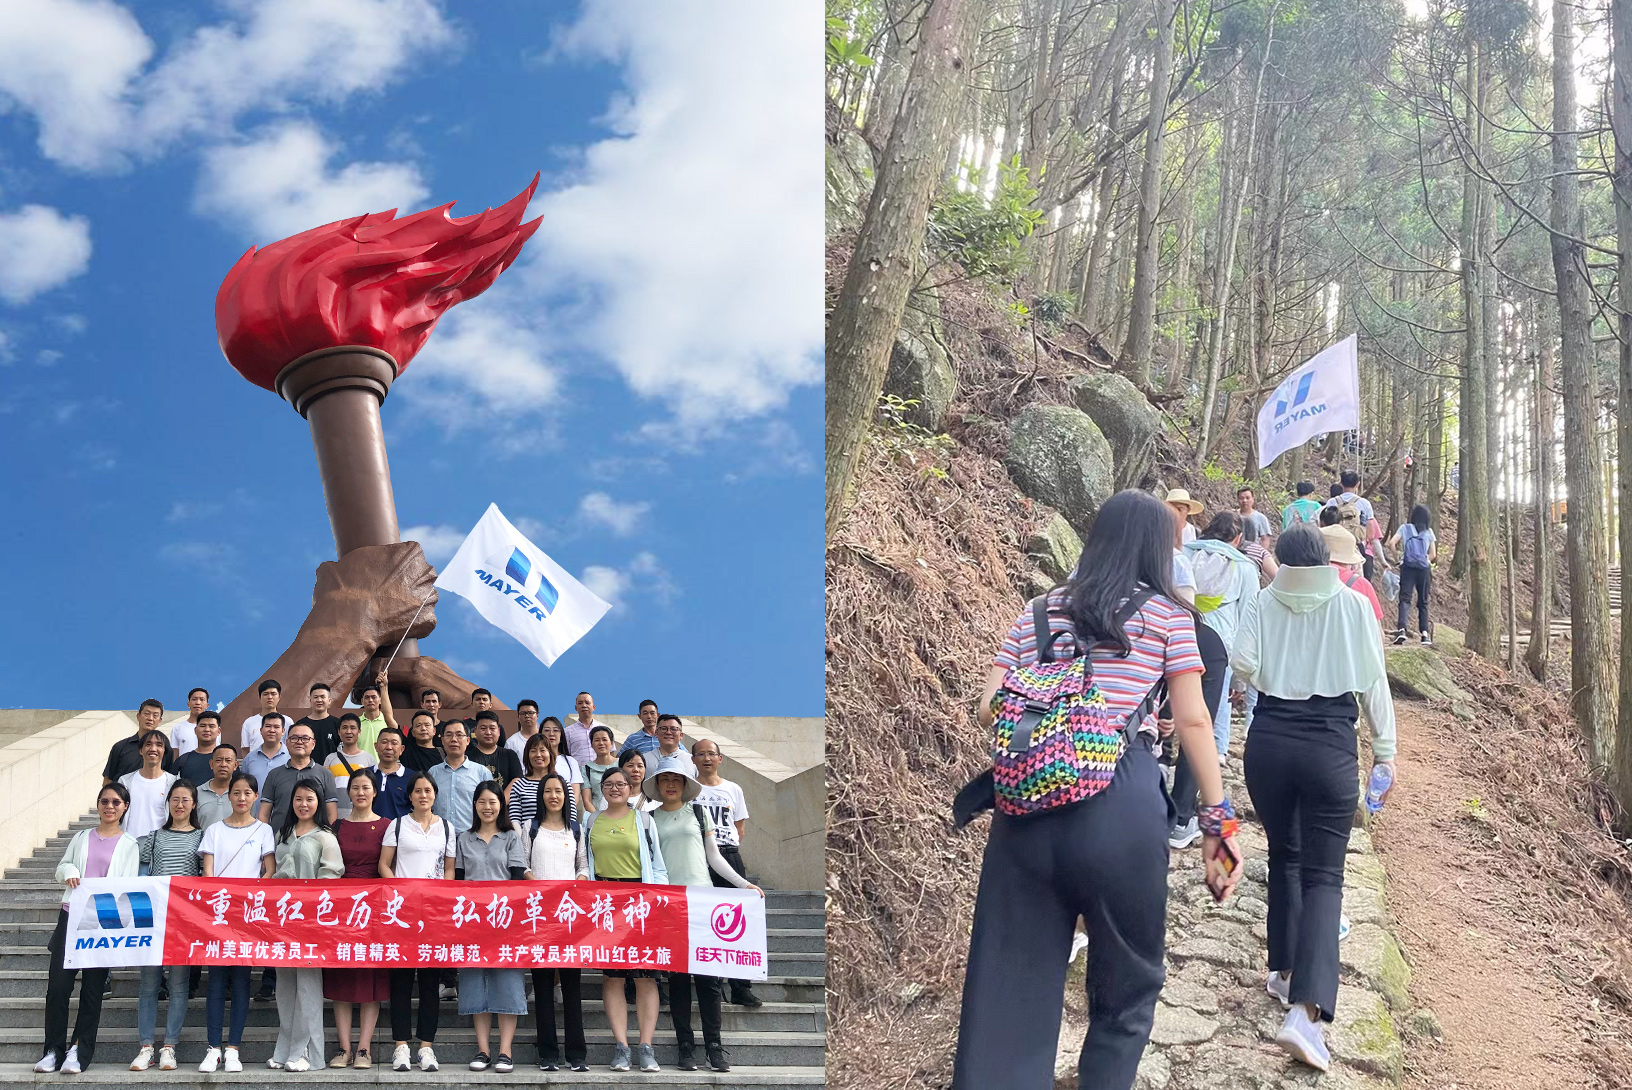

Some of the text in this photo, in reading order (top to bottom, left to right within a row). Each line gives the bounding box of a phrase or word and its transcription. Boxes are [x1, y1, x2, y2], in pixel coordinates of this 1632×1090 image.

[475, 569, 546, 622] MAYER
[75, 935, 153, 950] MAYER
[188, 939, 671, 965] 广州美亚优秀员工、销售精英、劳动模范、共产党员井冈山红色之旅
[695, 946, 762, 967] 佳天下旅游
